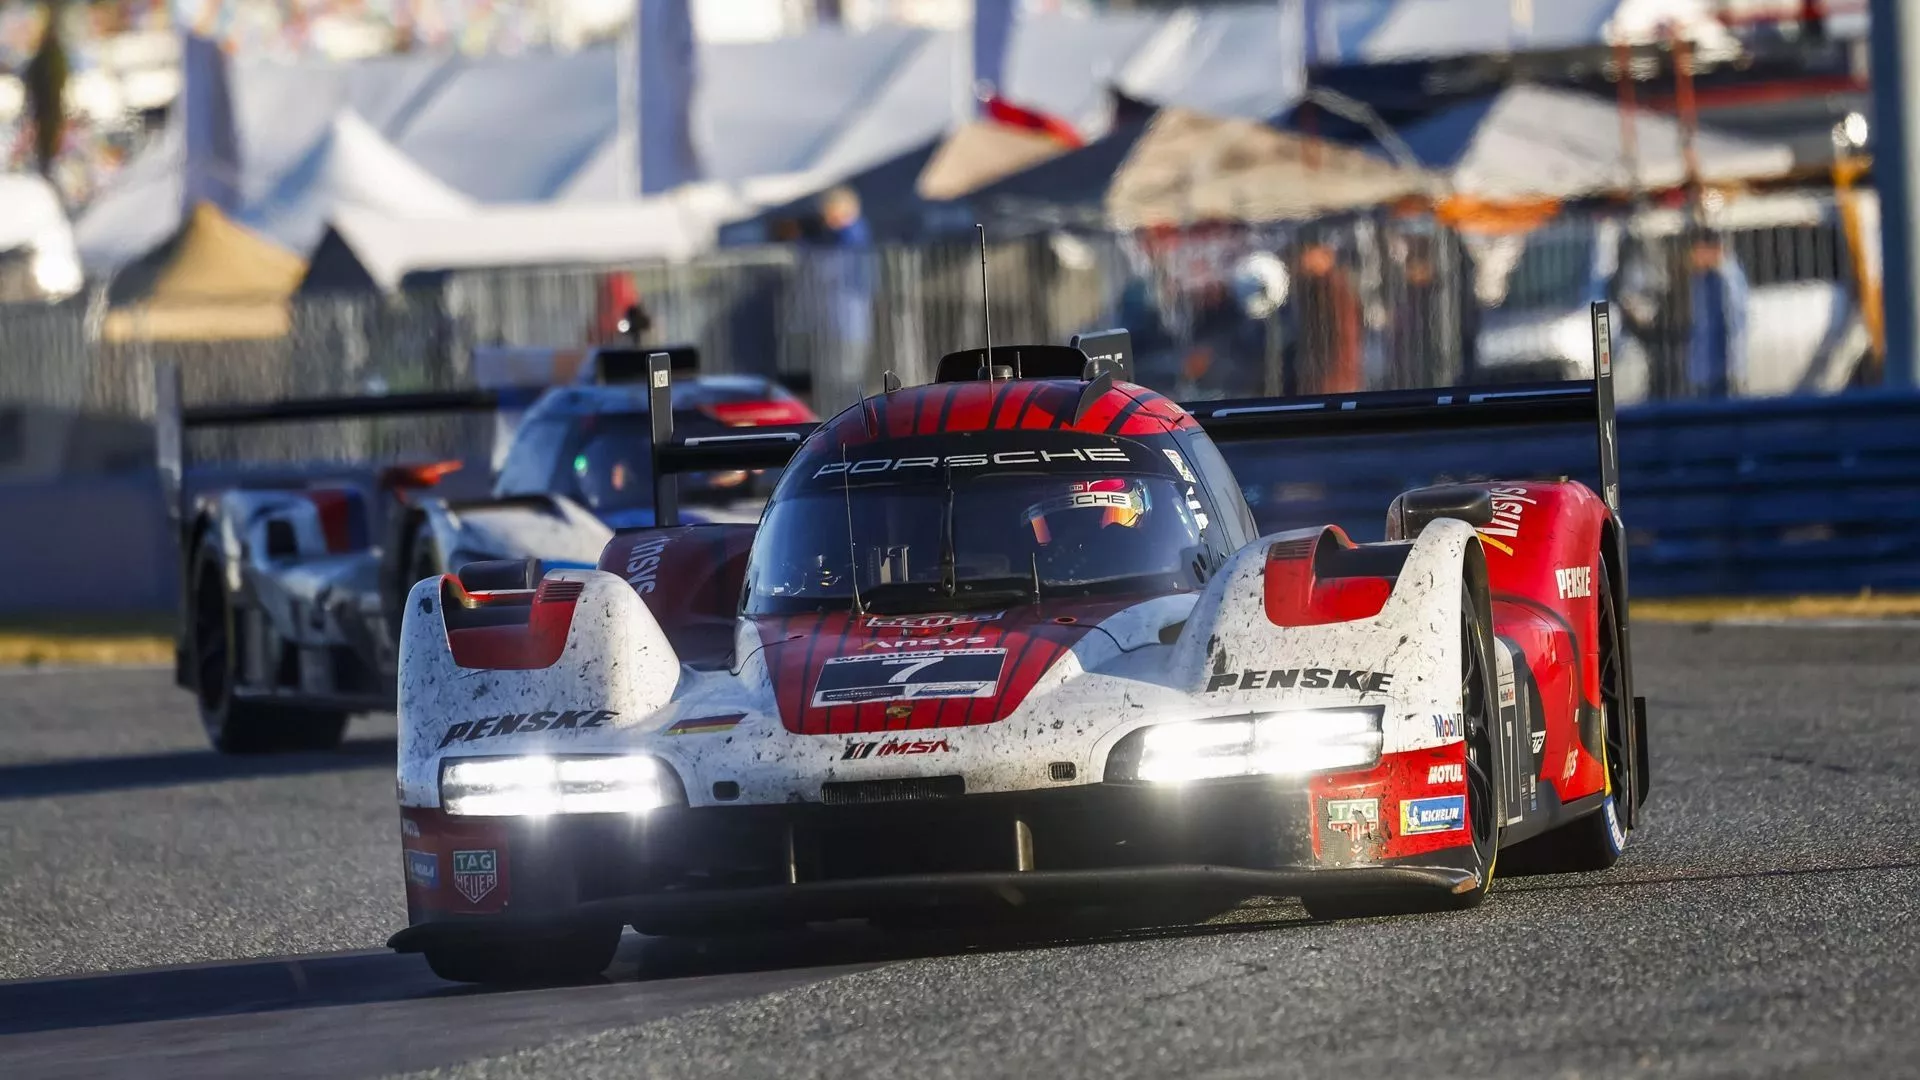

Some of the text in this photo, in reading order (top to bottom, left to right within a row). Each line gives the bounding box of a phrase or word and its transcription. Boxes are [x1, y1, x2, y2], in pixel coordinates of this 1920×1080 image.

[812, 446, 1131, 480] PORSCHE
[1555, 566, 1591, 600] PENSKE
[858, 636, 987, 650] Ansys
[881, 656, 944, 684] 7
[1205, 668, 1394, 693] PENSKE
[438, 710, 621, 749] PENSKE
[1432, 712, 1456, 738] Mobil
[876, 740, 950, 757] IMSA
[1427, 763, 1463, 784] MOTUL
[1333, 803, 1375, 820] TAG
[1421, 807, 1459, 823] MICHELIN
[456, 854, 492, 870] TAG
[456, 874, 494, 899] HEUER
